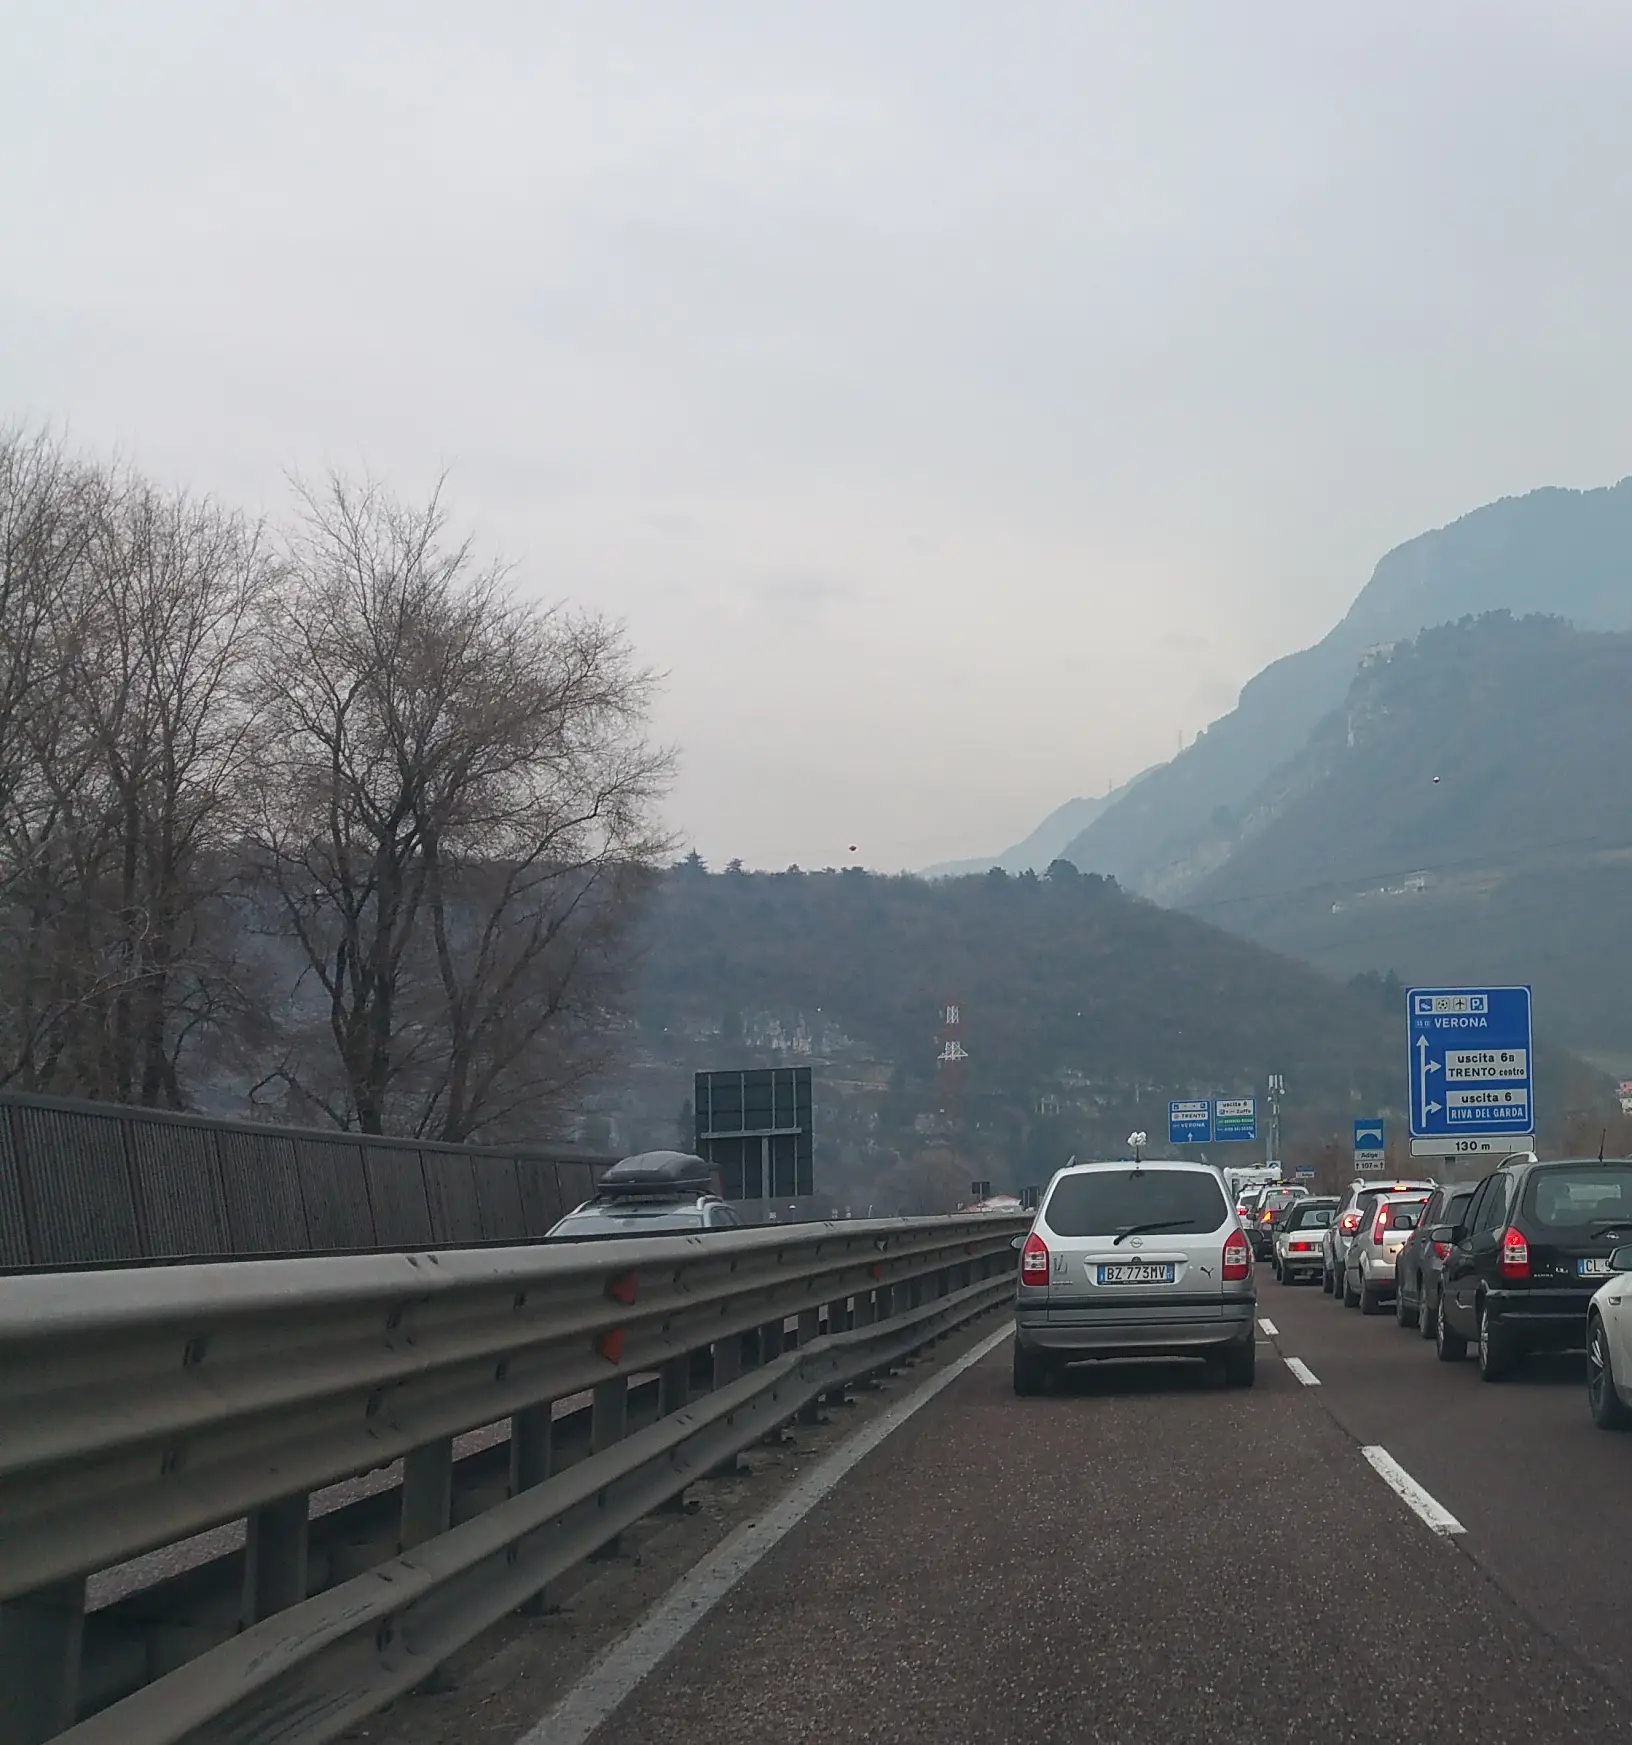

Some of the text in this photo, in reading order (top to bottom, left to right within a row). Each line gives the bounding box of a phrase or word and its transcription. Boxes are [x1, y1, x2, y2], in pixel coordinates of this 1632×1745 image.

[1434, 1017, 1488, 1028] VERONA
[1457, 1052, 1495, 1064] uscita
[1448, 1066, 1525, 1078] TRENTO centro
[1461, 1092, 1512, 1104] uscita 6
[1451, 1107, 1524, 1119] RIVA DEL GARDA
[1455, 1141, 1478, 1151] 130
[1107, 1266, 1166, 1280] BZ 773MV
